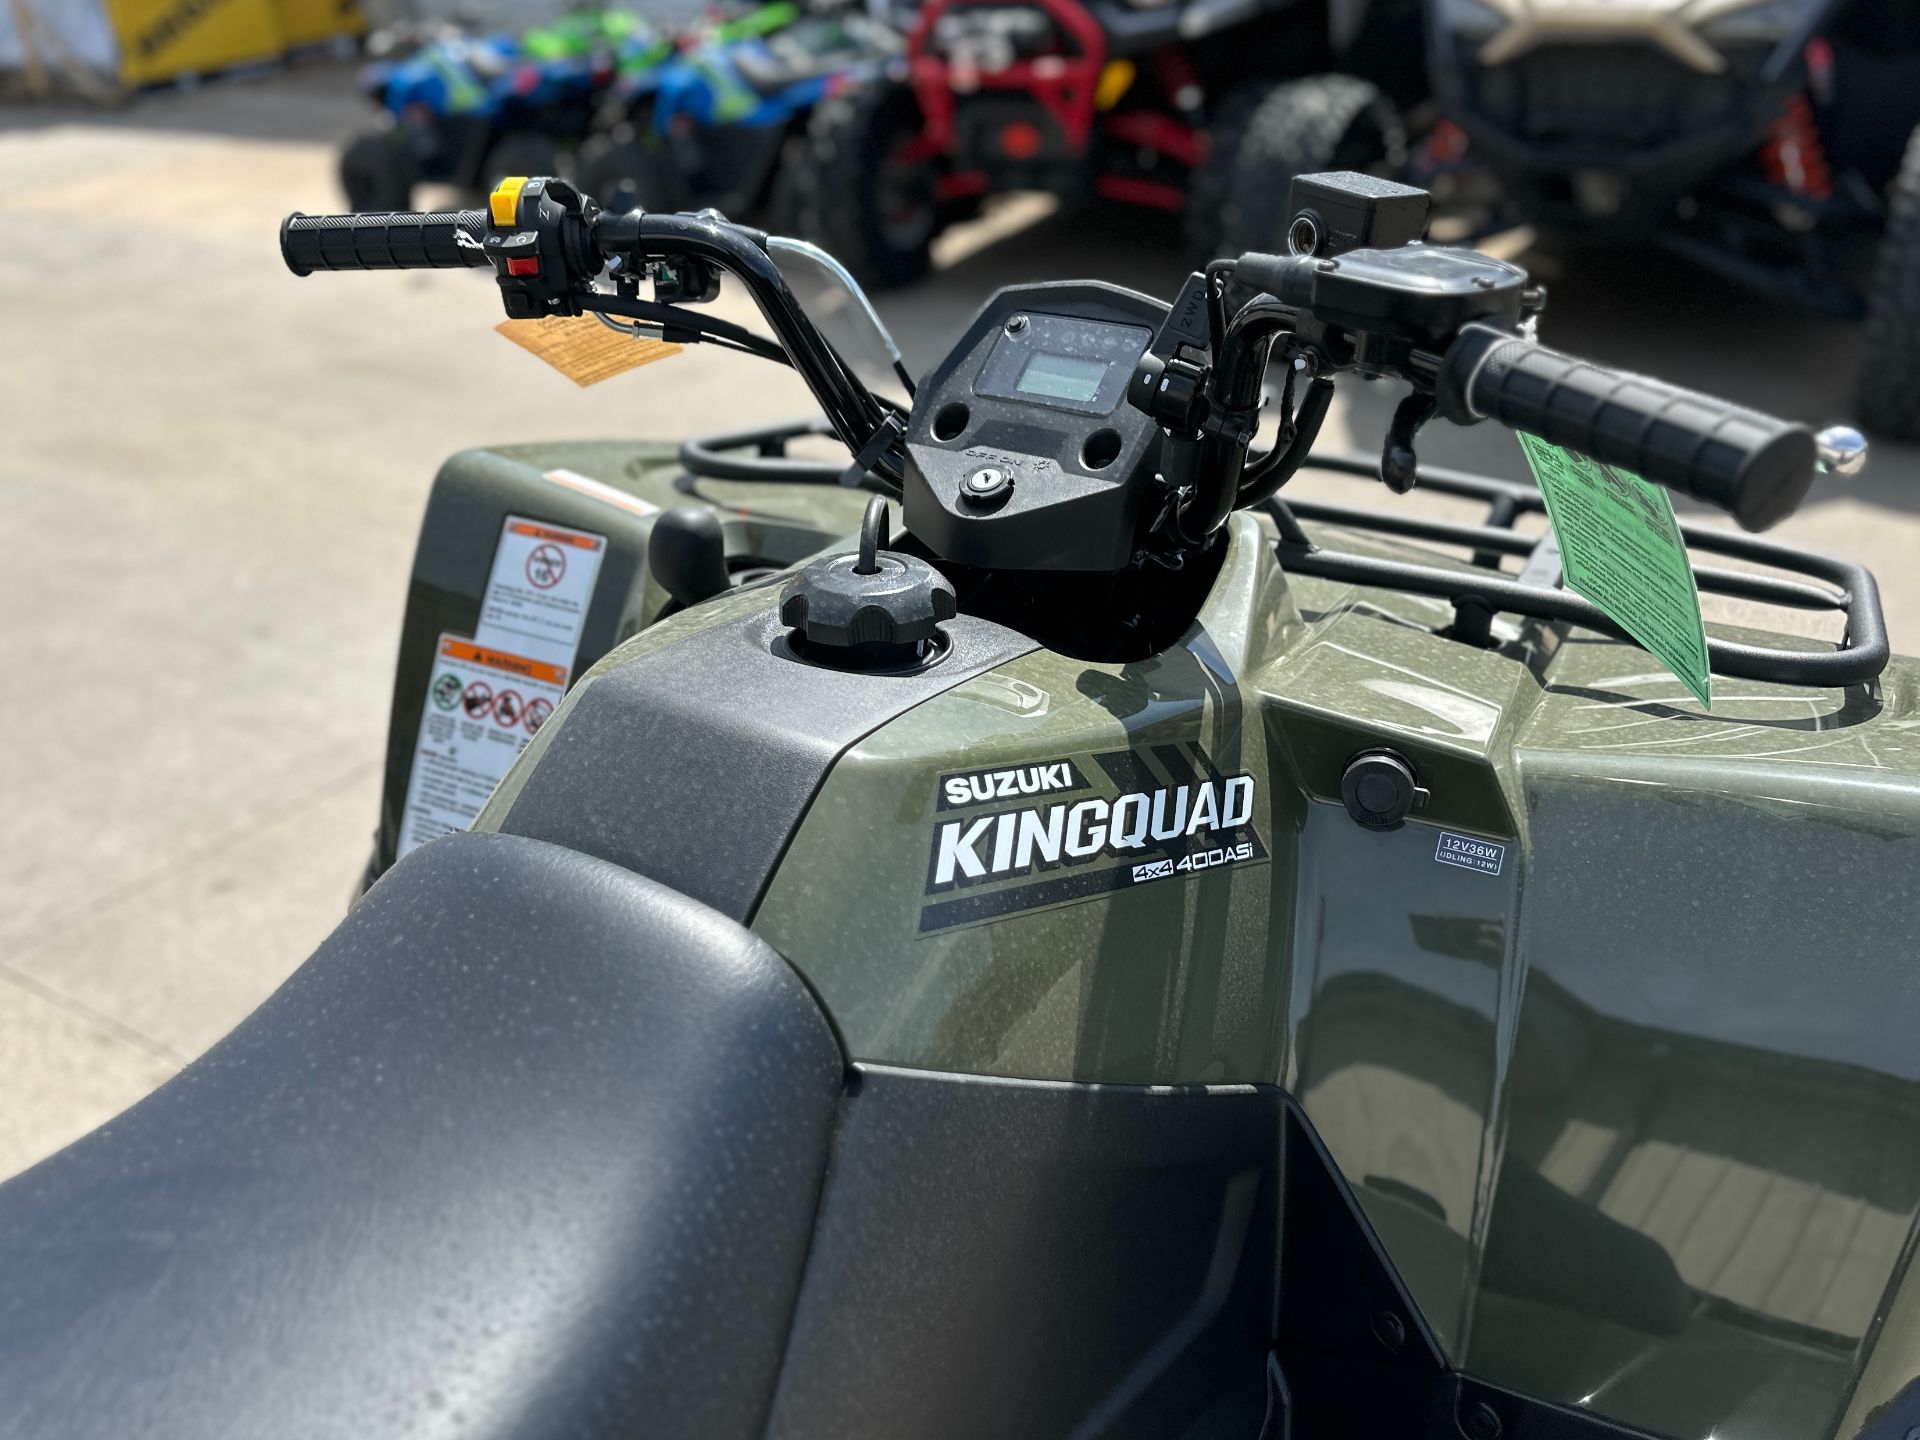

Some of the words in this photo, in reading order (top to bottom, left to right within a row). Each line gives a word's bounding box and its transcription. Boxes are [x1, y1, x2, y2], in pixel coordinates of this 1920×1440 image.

[945, 763, 1072, 803] SUZUKI
[935, 776, 1255, 884] KINGQUAD
[1446, 838, 1498, 858] 12V36W
[1134, 860, 1173, 879] 4x4
[1176, 842, 1253, 871] 400ASi
